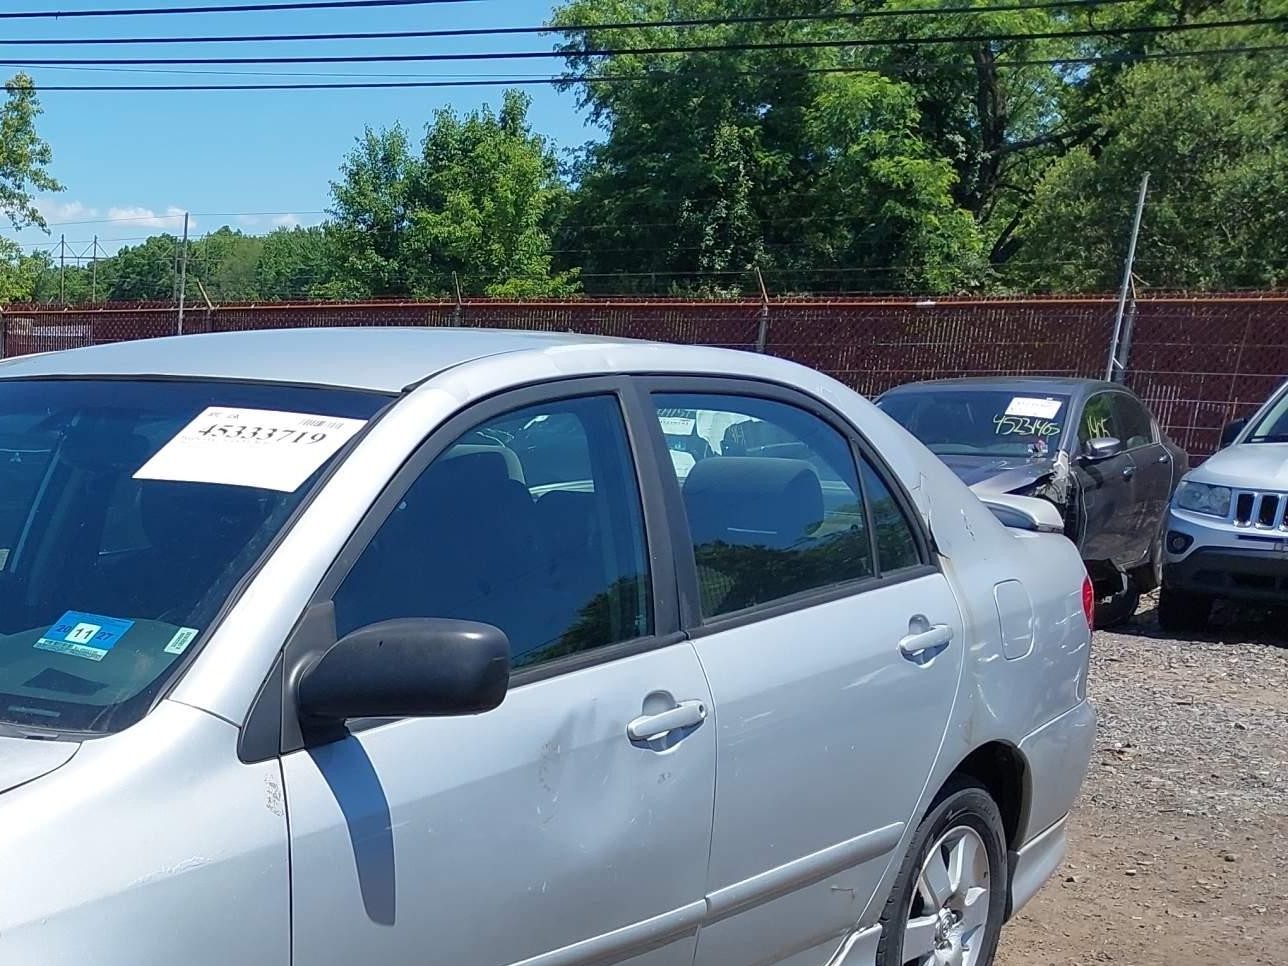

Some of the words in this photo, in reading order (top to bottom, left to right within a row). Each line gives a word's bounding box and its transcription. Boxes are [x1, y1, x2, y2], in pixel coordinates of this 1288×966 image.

[198, 423, 327, 445] 45333719
[56, 624, 73, 634] 20
[74, 627, 94, 639] 11
[96, 631, 115, 641] 27
